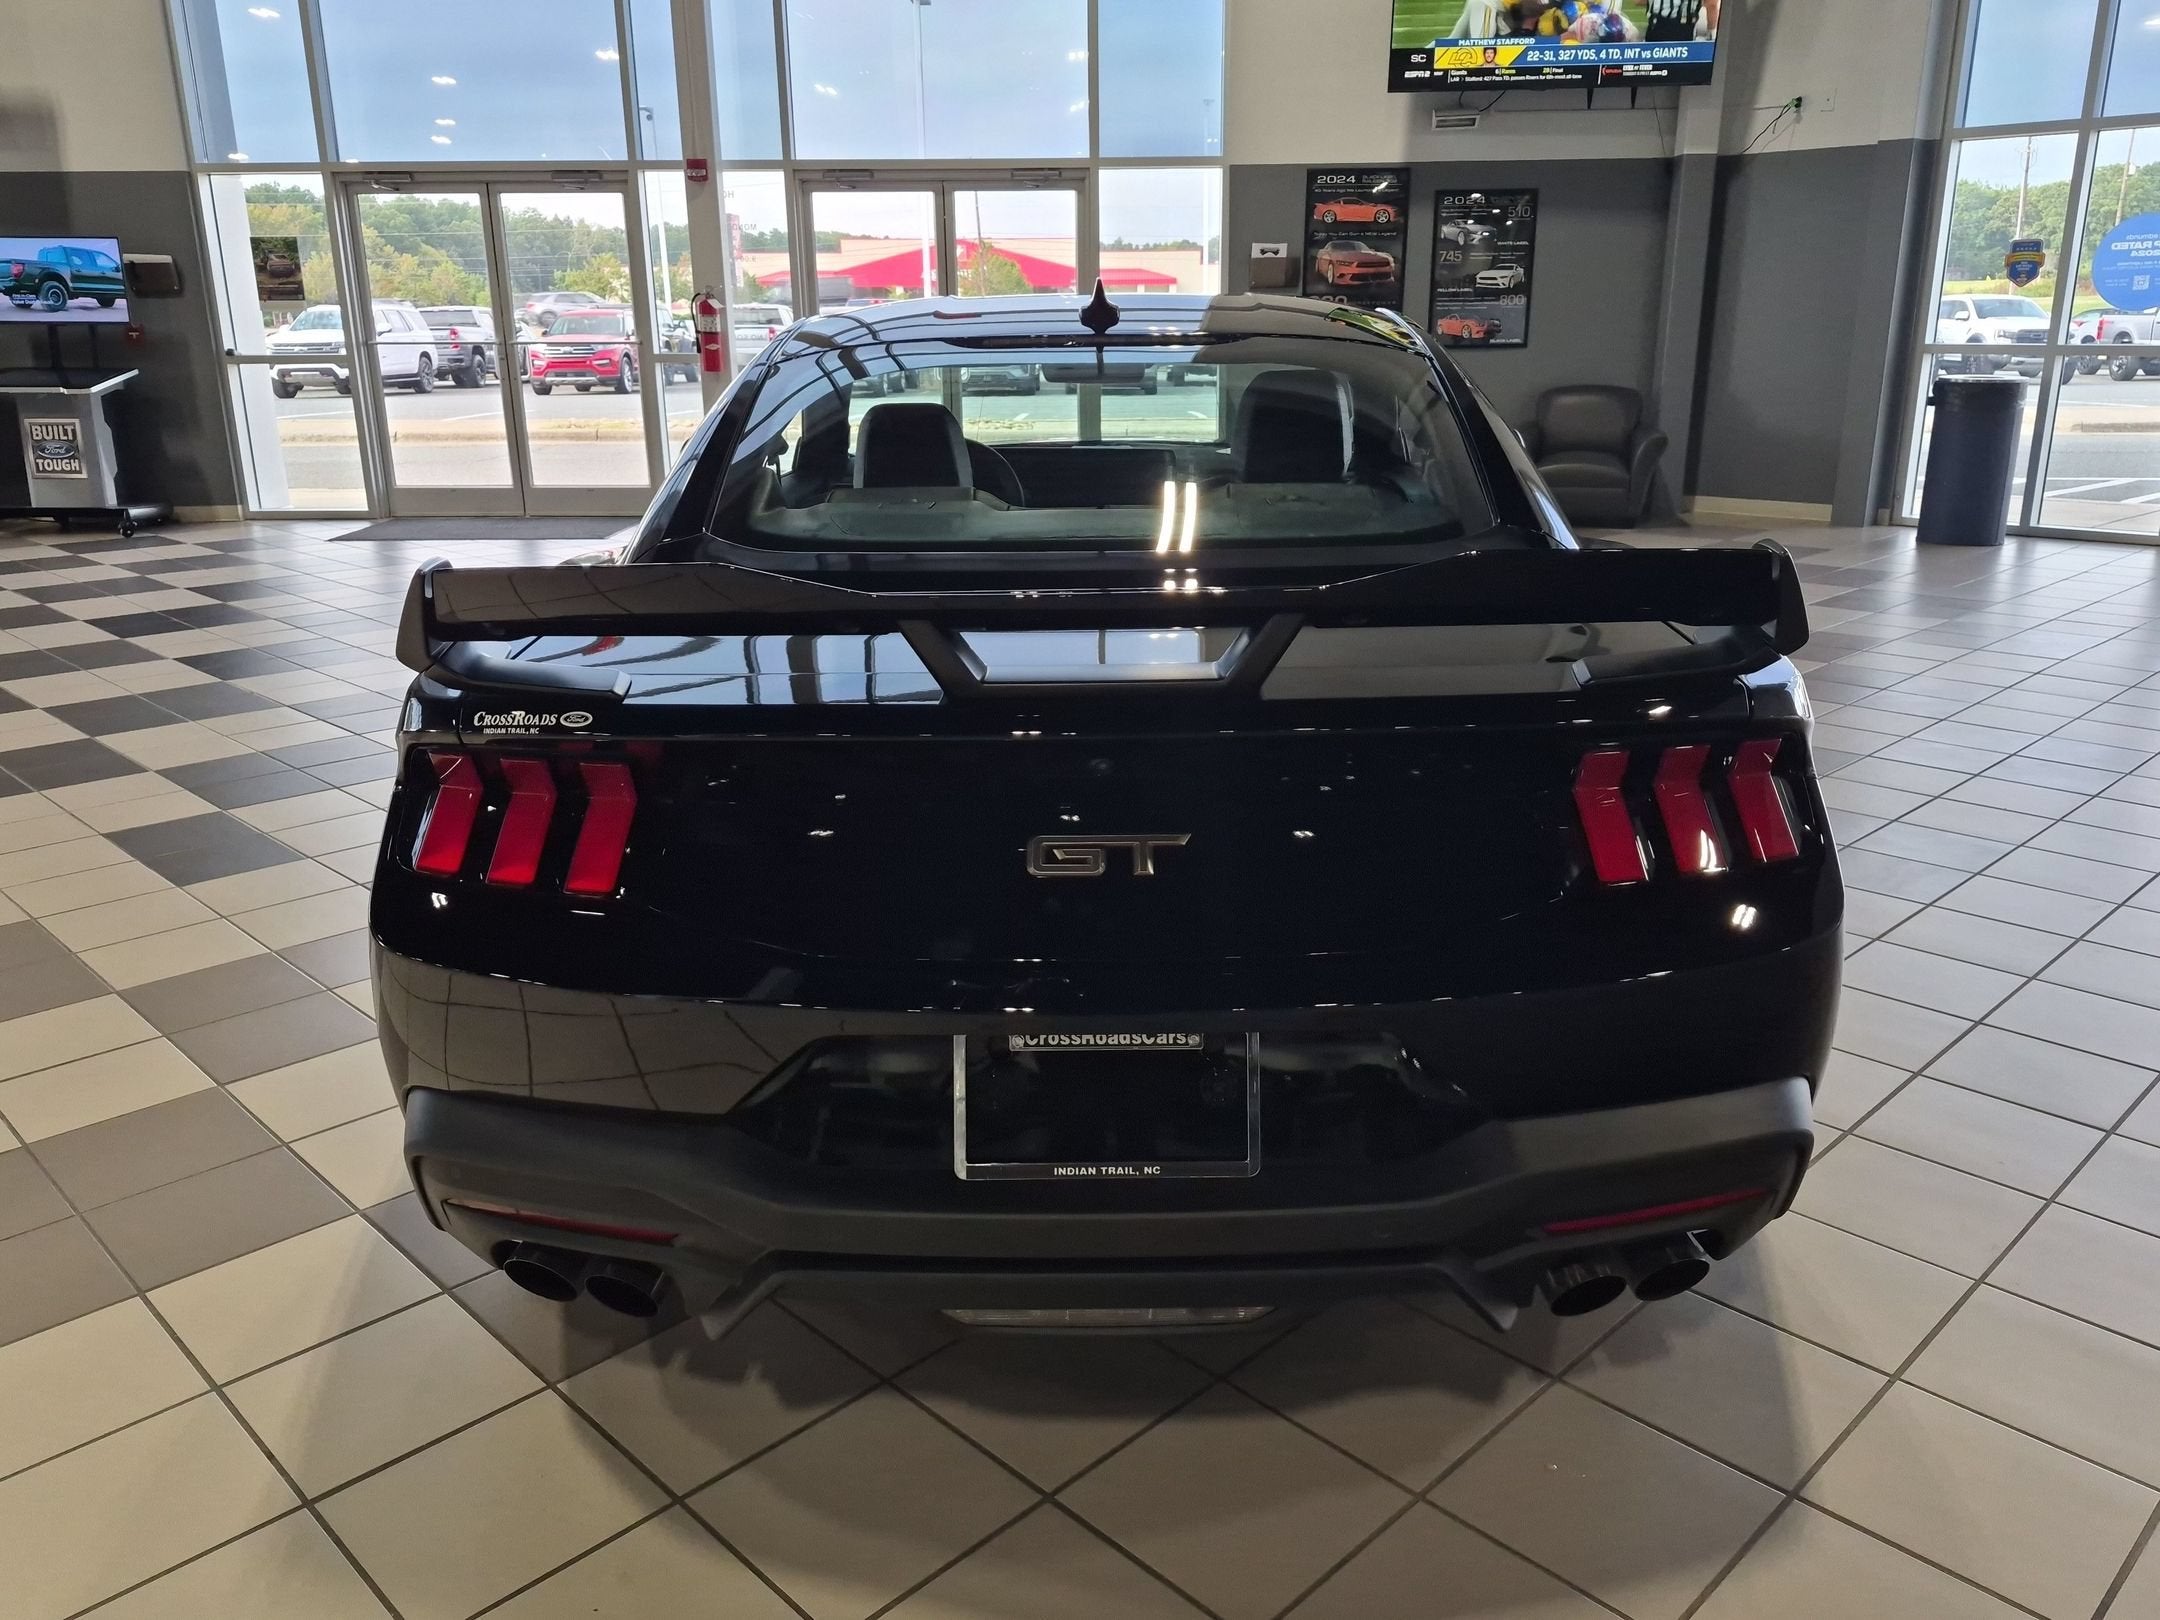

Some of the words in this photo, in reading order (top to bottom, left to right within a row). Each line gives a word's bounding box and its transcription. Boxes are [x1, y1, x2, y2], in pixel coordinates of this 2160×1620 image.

[1496, 37, 1535, 45] STAFFORD
[1410, 54, 1427, 62] SC
[1526, 50, 1556, 61] 22-31,
[1558, 50, 1576, 60] 327
[1577, 49, 1598, 60] YDS,
[1600, 49, 1606, 59] 4
[1608, 48, 1622, 60] TD,
[1624, 48, 1641, 58] INT
[1641, 50, 1651, 58] vs
[1652, 47, 1688, 58] GIANTS
[1317, 175, 1356, 184] 2024
[1443, 195, 1486, 205] 2024
[1507, 206, 1531, 217] 510
[1440, 250, 1463, 262] 745
[31, 425, 74, 440] BUILT
[44, 444, 66, 454] Ford
[35, 459, 80, 471] TOUGH
[507, 727, 529, 735] TRAIL,
[1026, 833, 1192, 878] GT
[1053, 1166, 1097, 1176] INDIAN
[1100, 1166, 1139, 1176] TRAIL,
[1143, 1166, 1161, 1175] NC
